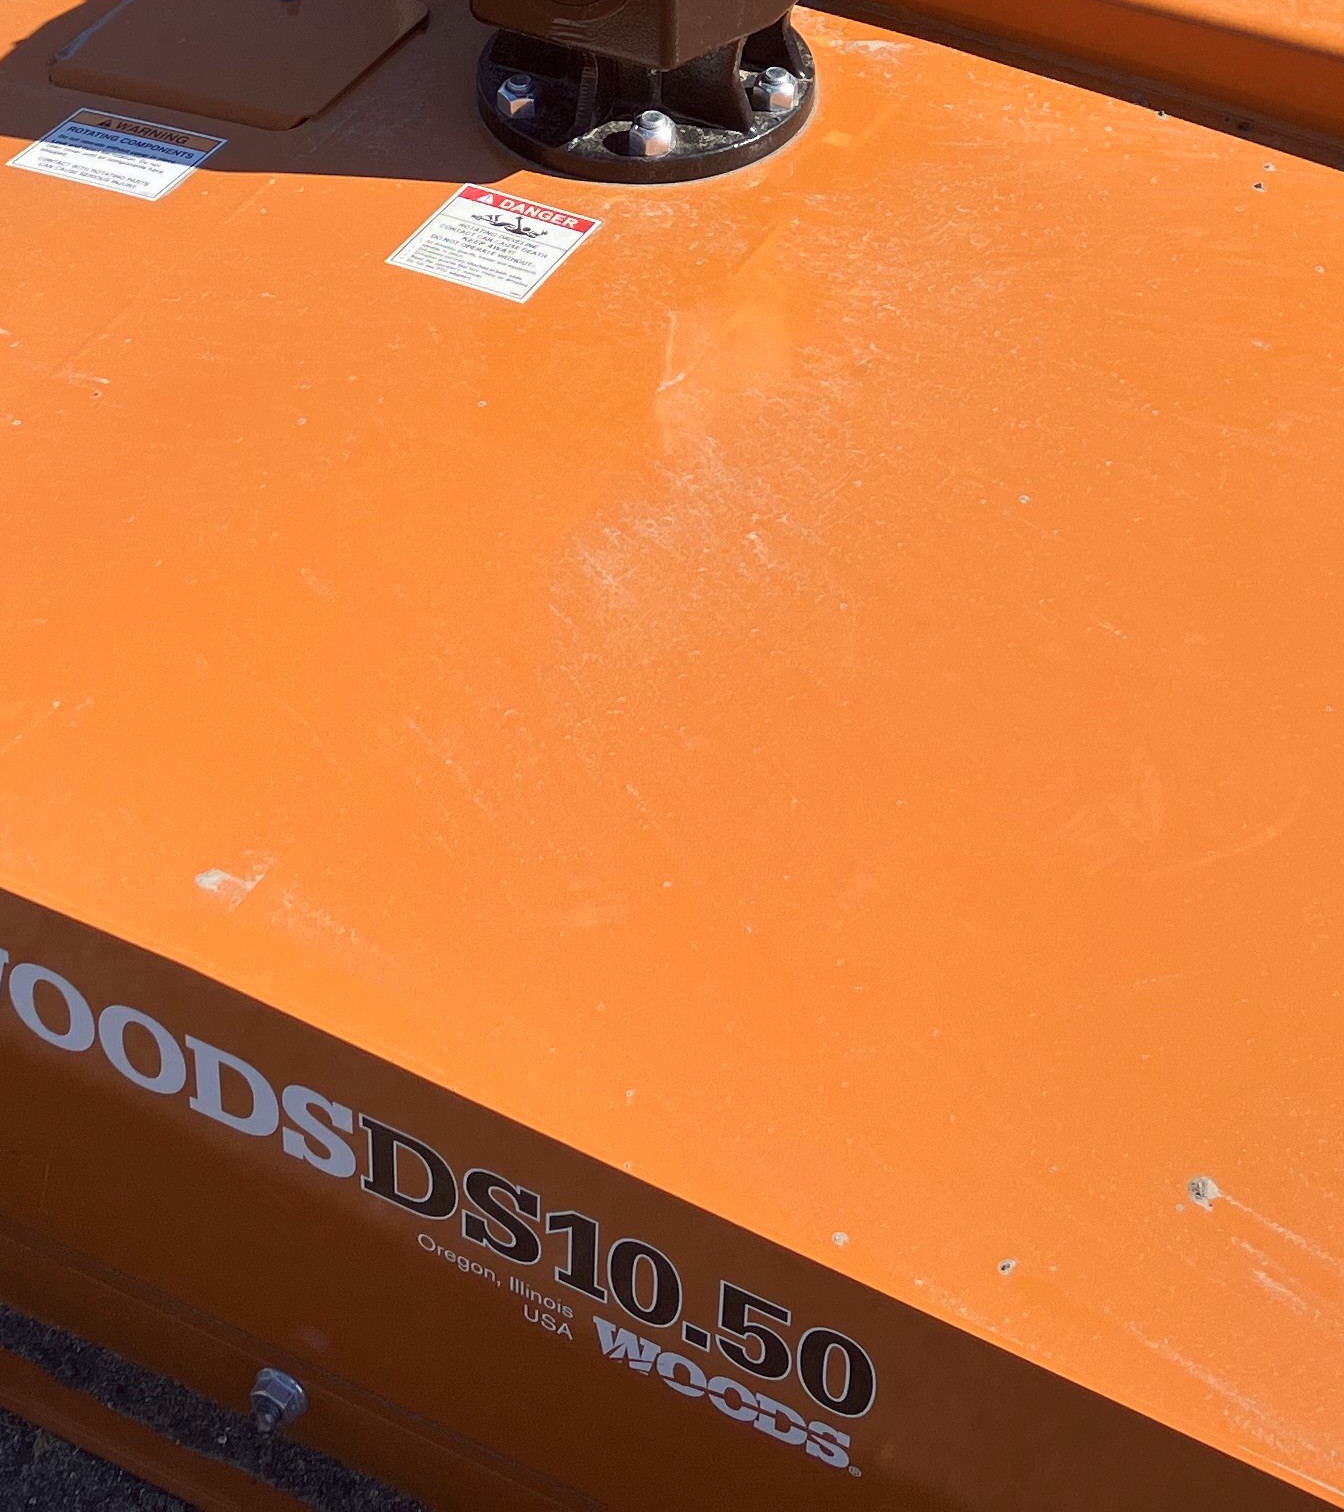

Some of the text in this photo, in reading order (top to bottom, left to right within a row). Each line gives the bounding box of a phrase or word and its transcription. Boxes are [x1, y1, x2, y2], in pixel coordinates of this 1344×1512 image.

[65, 125, 121, 141] ROTATING
[117, 137, 196, 159] COMPONENTS
[111, 121, 192, 144] WARNING
[496, 198, 582, 228] DANGER
[359, 1115, 877, 1419] DS10.50
[417, 1232, 574, 1319] Oregon, Illinois
[522, 1303, 573, 1341] USA
[593, 1315, 852, 1469] WOODS
